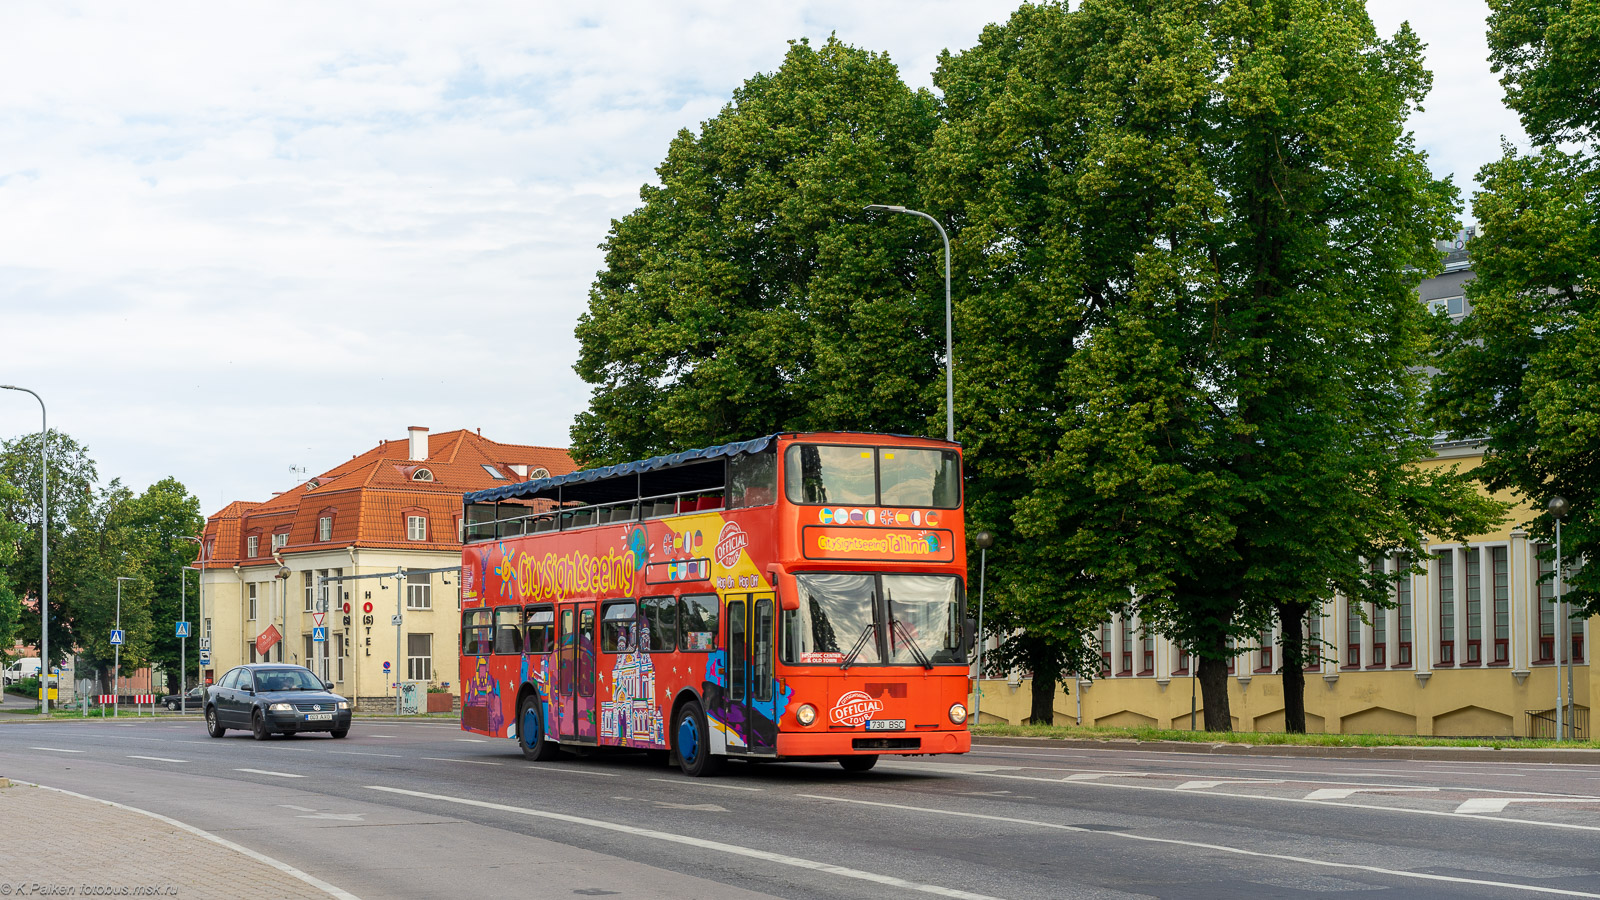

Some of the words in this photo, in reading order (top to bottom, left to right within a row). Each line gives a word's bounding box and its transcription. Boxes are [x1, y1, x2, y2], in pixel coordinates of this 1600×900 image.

[717, 534, 747, 559] OFFICIAL
[818, 535, 888, 553] CitySightseeing
[886, 533, 929, 554] Tallinn
[725, 551, 741, 565] TOUR
[518, 547, 635, 601] CitySightseeing
[716, 576, 726, 590] Hop
[727, 575, 735, 589] On
[738, 575, 749, 589] Hop
[750, 574, 759, 588] Off
[835, 701, 880, 719] OFFICIAL
[849, 714, 870, 724] TOUR
[872, 721, 885, 729] 730
[888, 721, 904, 729] BSC
